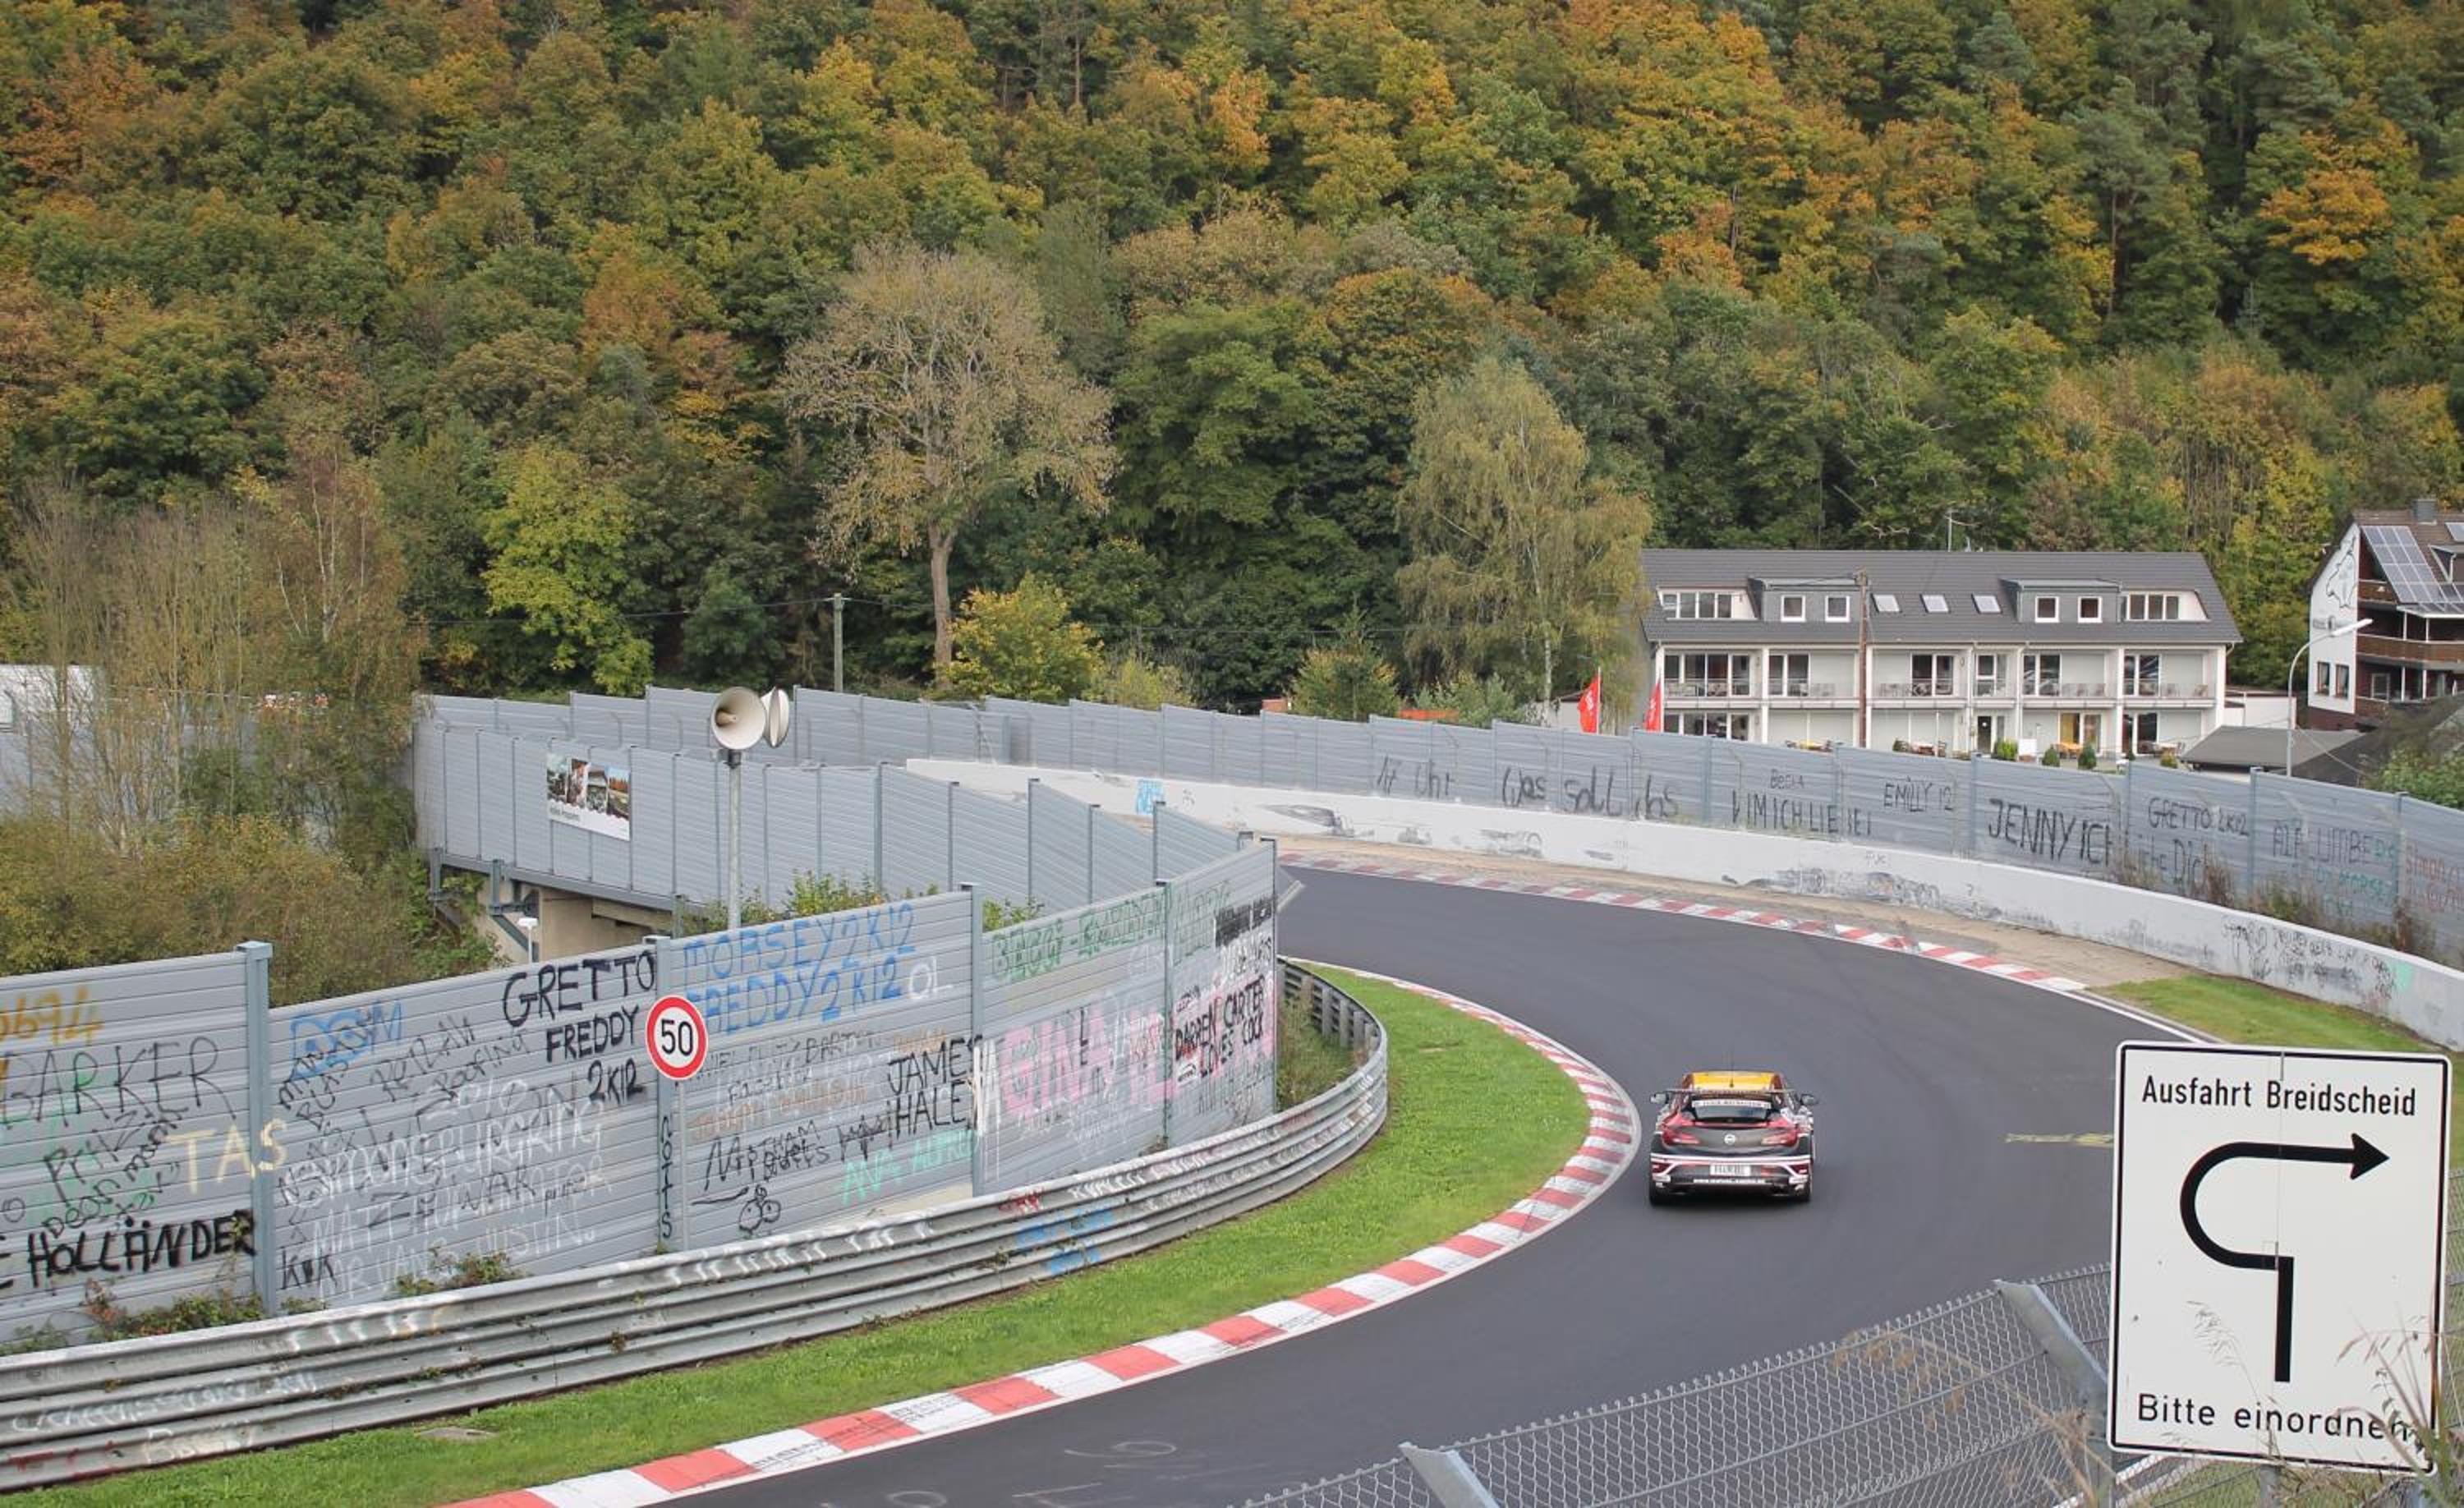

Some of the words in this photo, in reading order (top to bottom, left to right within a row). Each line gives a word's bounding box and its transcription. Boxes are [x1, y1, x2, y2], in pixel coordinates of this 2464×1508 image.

[1988, 798, 2076, 862] JENNY
[503, 949, 656, 1028] GRETTO
[545, 1005, 640, 1064] FREDDY
[661, 1020, 694, 1057] 50
[2142, 1075, 2252, 1108] Ausfahrt
[2266, 1079, 2416, 1117] Breidscheid
[164, 1117, 290, 1196] TAS
[27, 1208, 256, 1288] HOLLÄNDER
[2139, 1393, 2216, 1428] Bitte
[2235, 1401, 2413, 1444] einordnen
